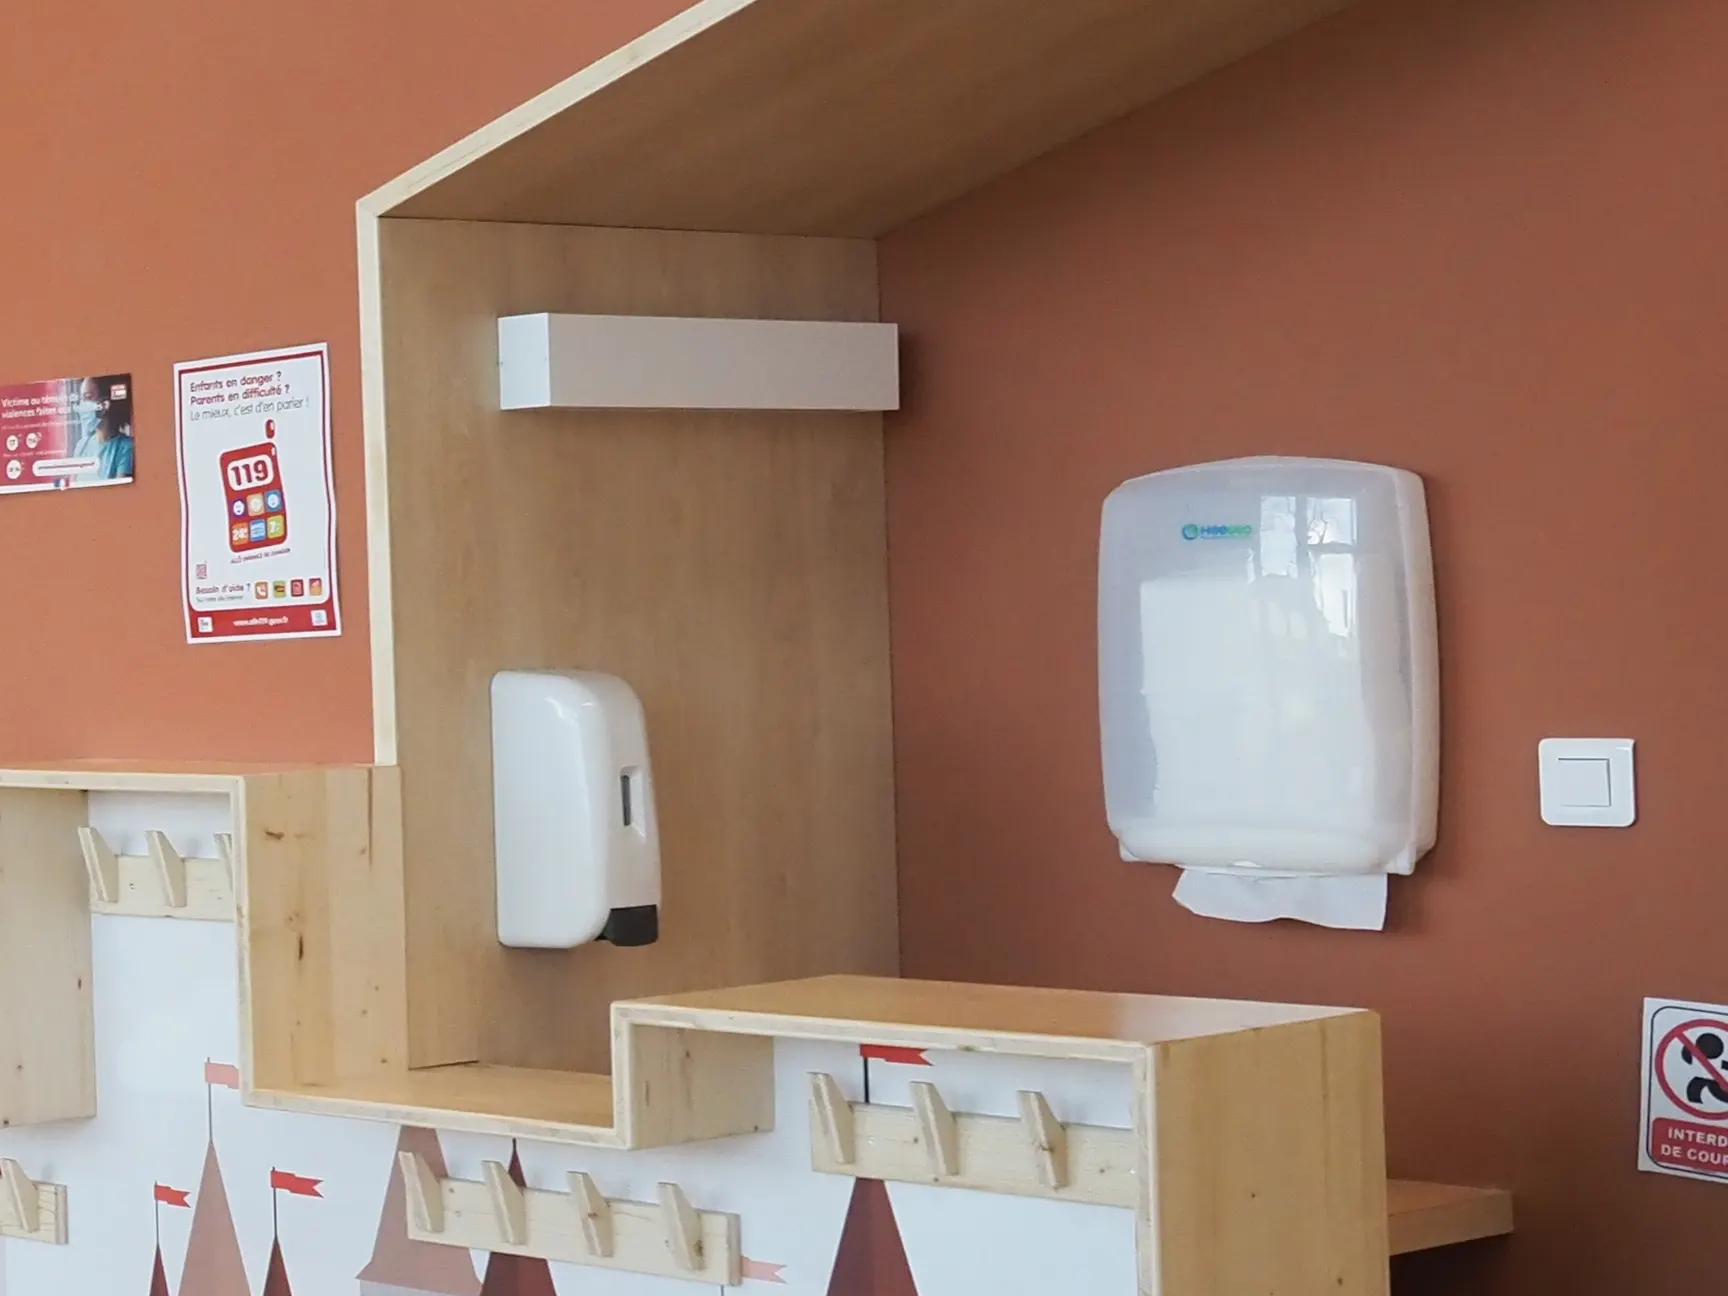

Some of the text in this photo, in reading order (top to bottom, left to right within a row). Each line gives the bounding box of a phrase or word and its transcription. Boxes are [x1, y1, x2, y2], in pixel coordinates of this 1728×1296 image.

[190, 371, 282, 392] Enfants en danger ?
[190, 393, 225, 405] Parents
[228, 392, 239, 400] en
[242, 385, 282, 399] difficulté
[190, 410, 200, 421] Le
[234, 404, 253, 416] c'est
[255, 401, 275, 413] d'en
[276, 397, 303, 411] parler
[231, 460, 268, 486] 119
[1661, 1144, 1683, 1158] DE
